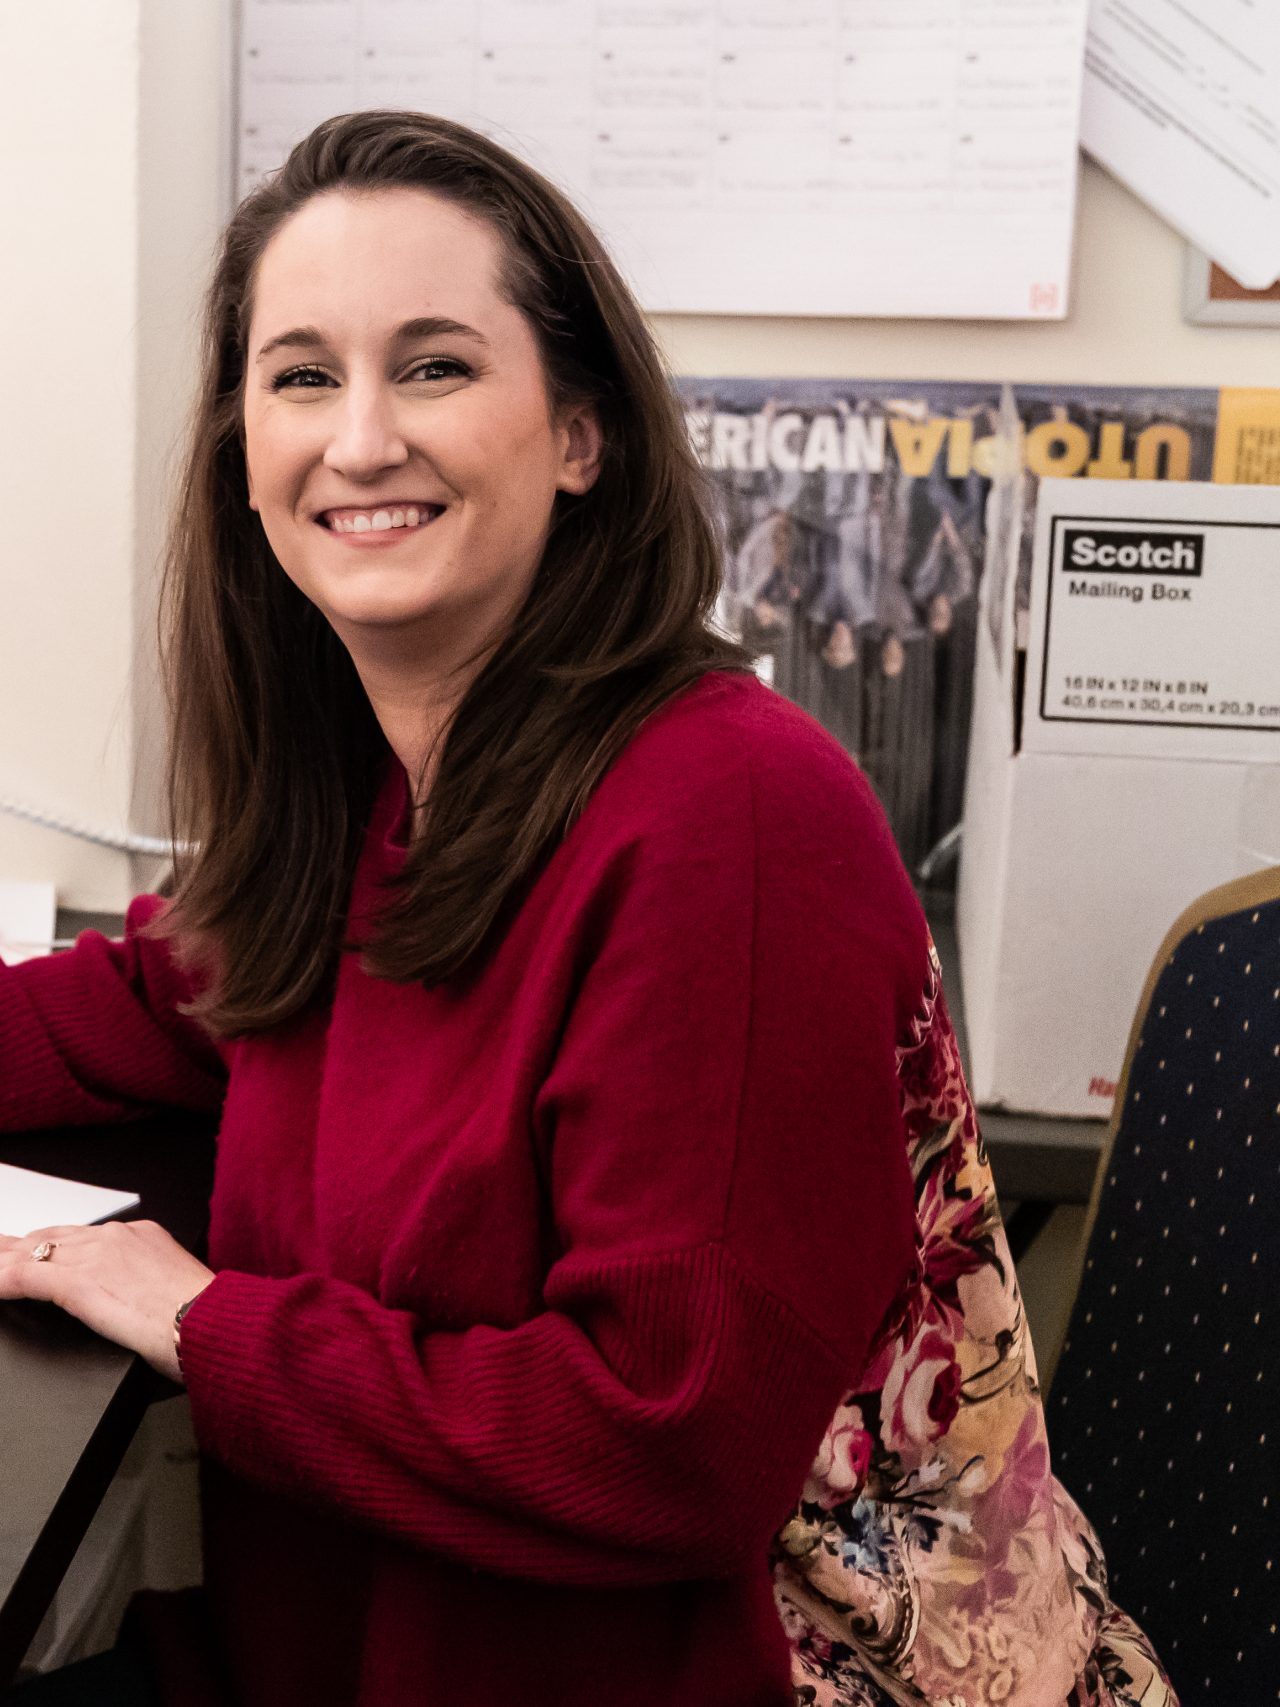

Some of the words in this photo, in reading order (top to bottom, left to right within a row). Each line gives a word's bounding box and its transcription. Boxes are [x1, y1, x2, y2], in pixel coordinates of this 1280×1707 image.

[1070, 536, 1196, 571] Scotch
[1069, 580, 1144, 603] Mailing
[1151, 582, 1192, 602] Box
[1065, 675, 1082, 690] 16
[1085, 676, 1105, 691] IN
[1122, 678, 1140, 692] 12
[1142, 678, 1161, 693] IN
[1176, 681, 1187, 695] 8
[1189, 681, 1208, 695] IN
[1100, 697, 1125, 711] cm
[1178, 701, 1204, 714] cm
